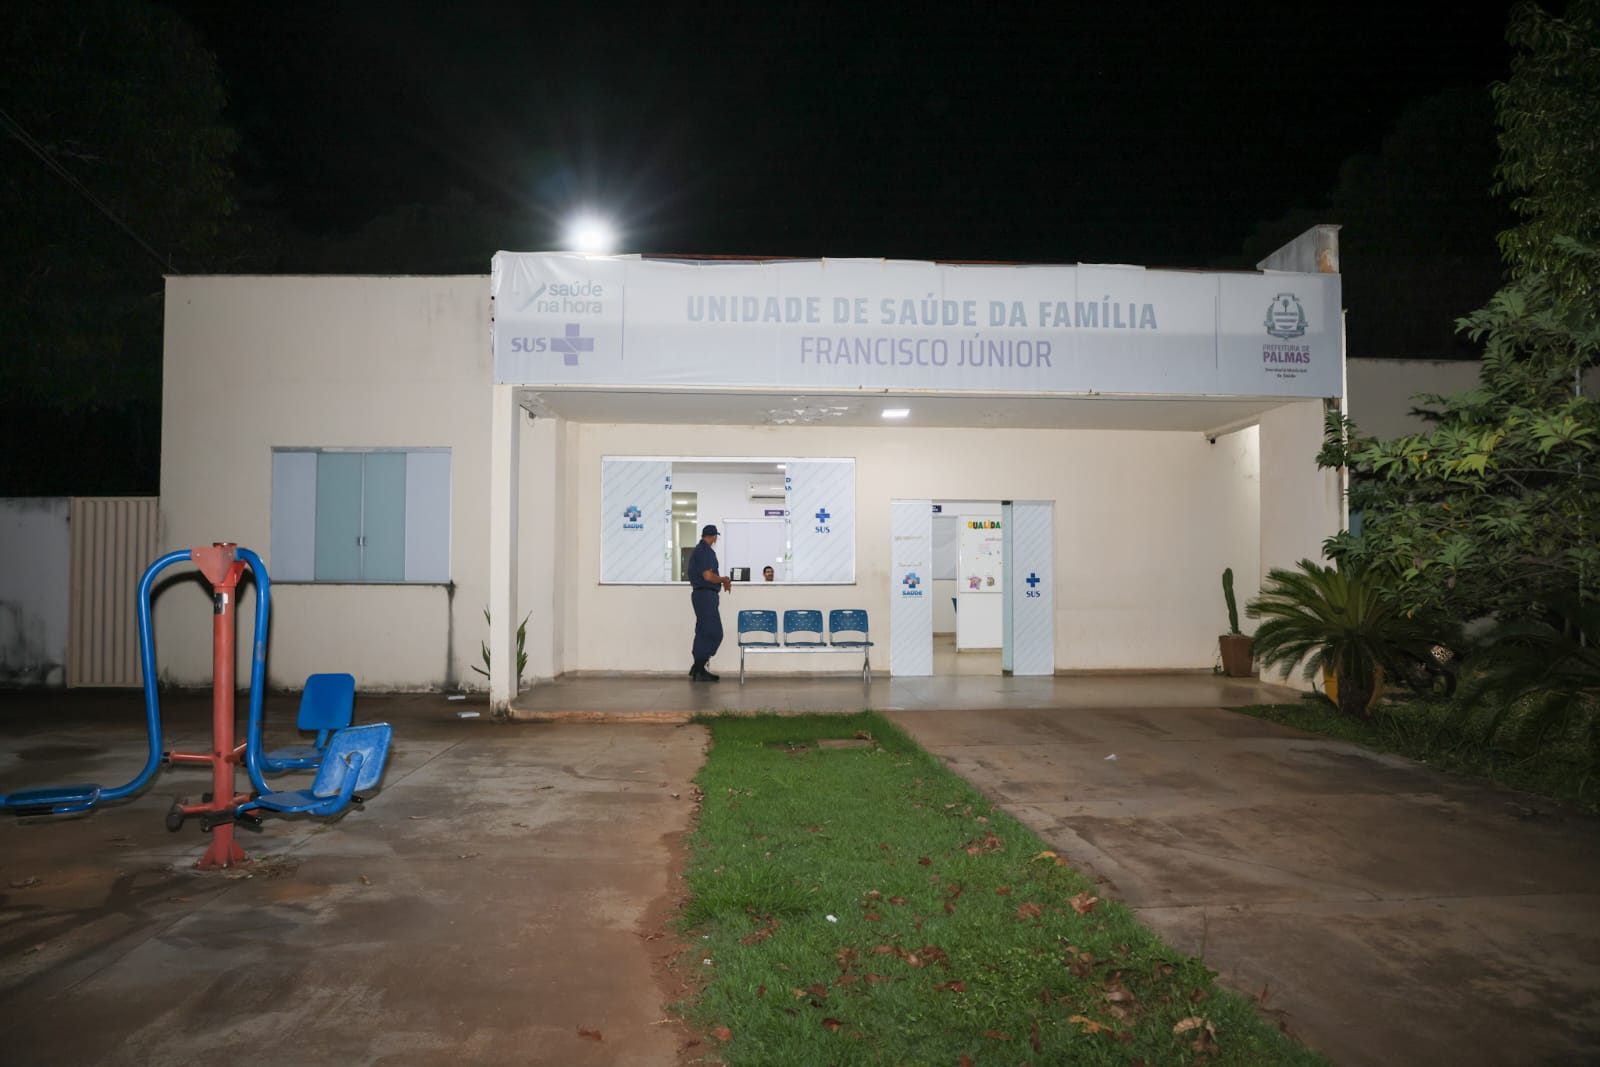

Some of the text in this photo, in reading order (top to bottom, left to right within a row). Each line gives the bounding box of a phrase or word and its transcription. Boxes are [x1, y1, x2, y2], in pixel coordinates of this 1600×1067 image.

[548, 280, 604, 297] saúde
[537, 297, 603, 313] na hora
[687, 292, 1158, 329] UNIDADE DE SAÚDE DA FAMÍLIA
[511, 337, 547, 353] SUS
[801, 332, 1053, 368] FRANCISCO JÚNIOR
[1263, 351, 1311, 364] PALMAS
[1026, 590, 1041, 598] SUS
